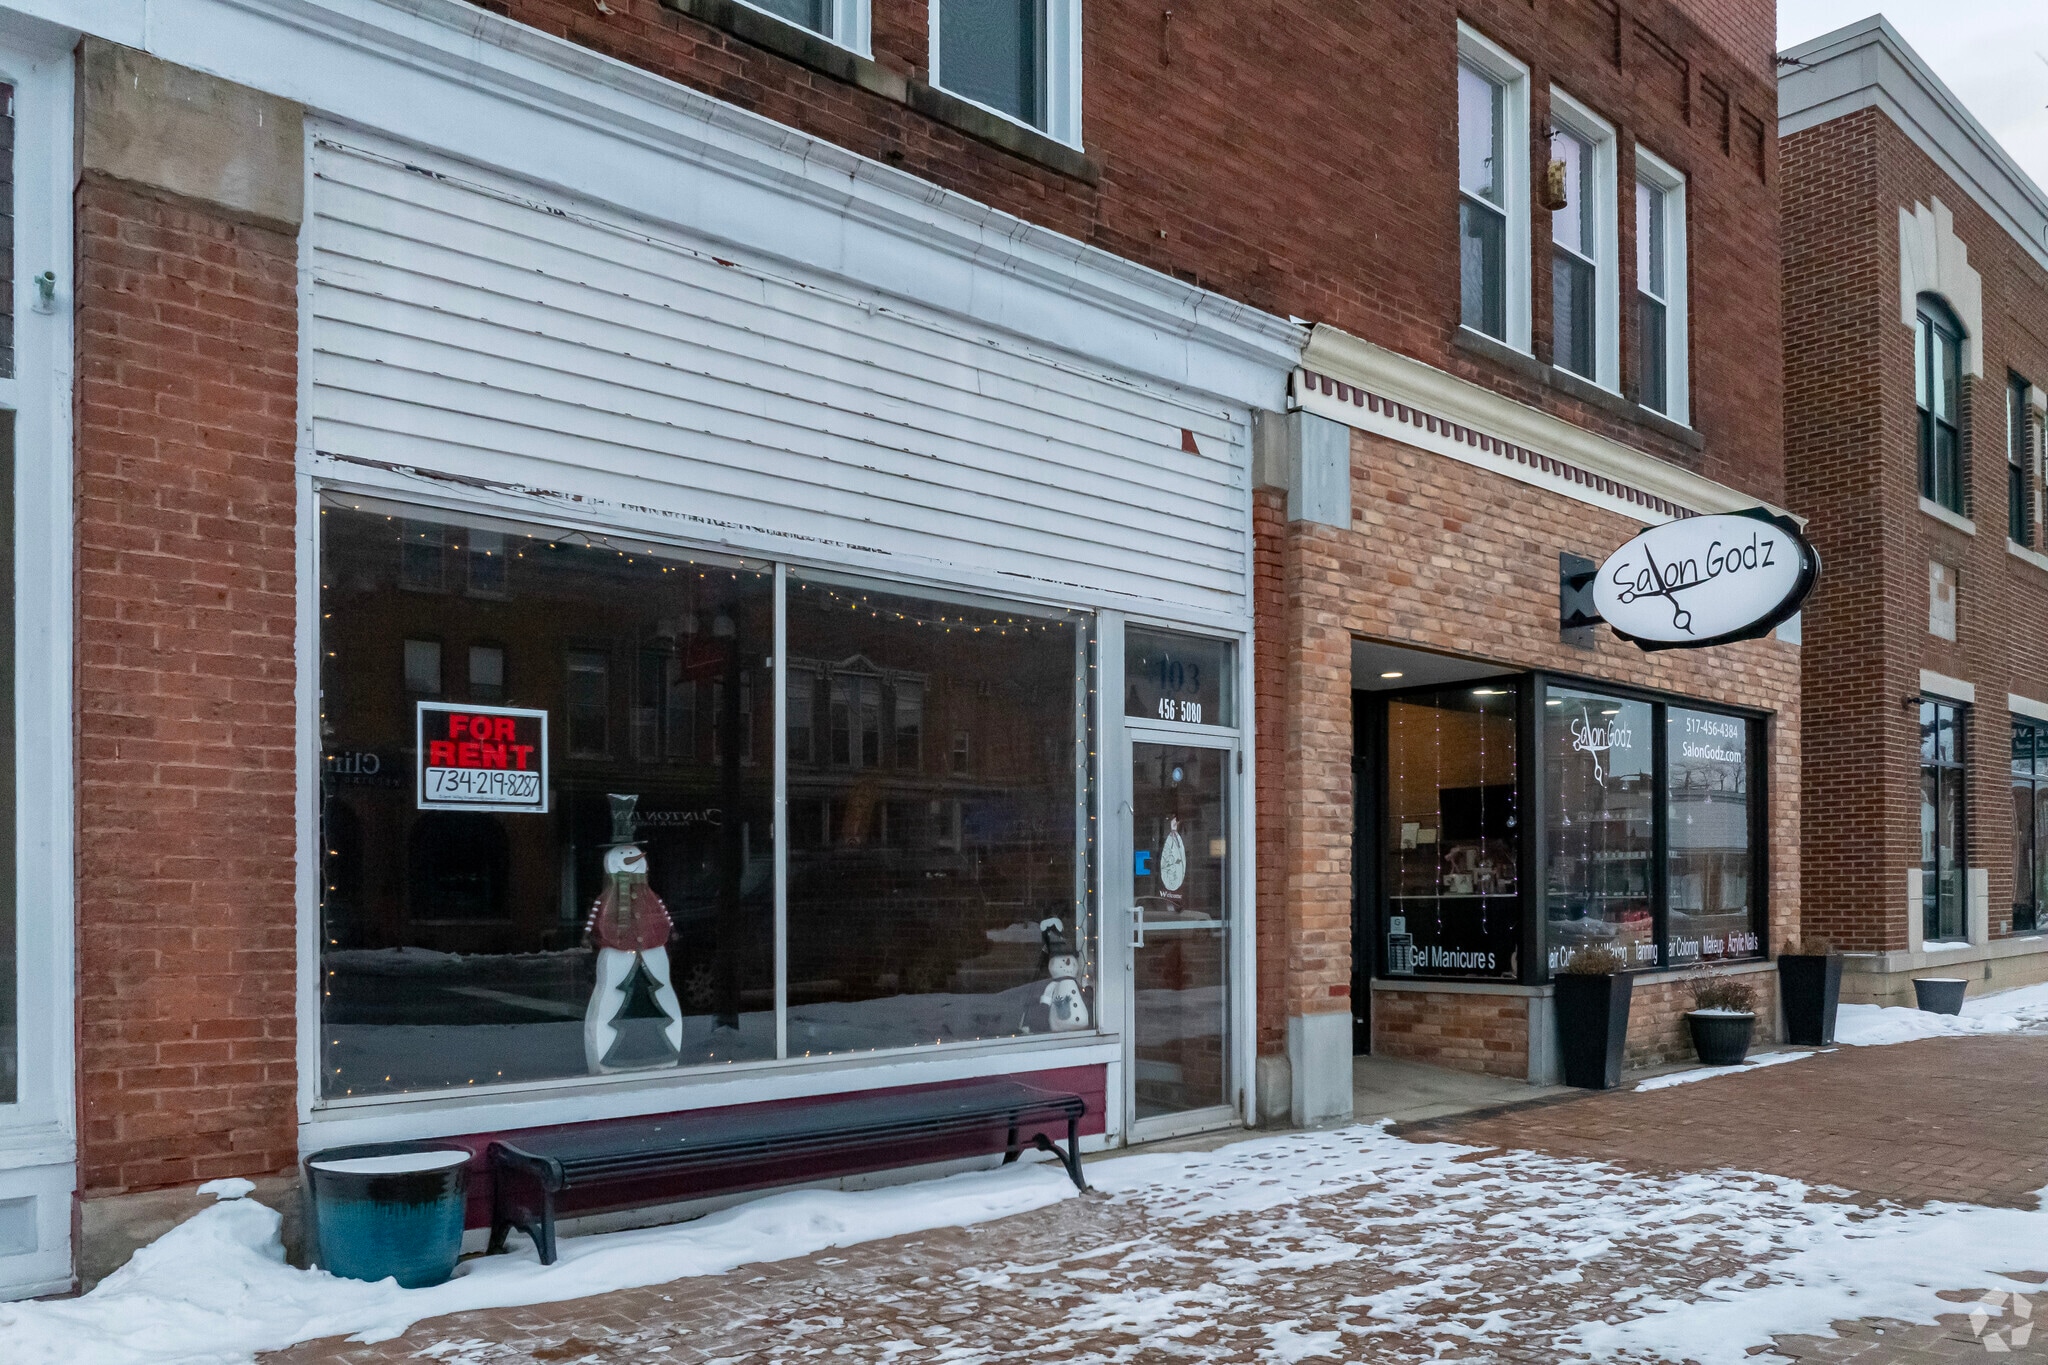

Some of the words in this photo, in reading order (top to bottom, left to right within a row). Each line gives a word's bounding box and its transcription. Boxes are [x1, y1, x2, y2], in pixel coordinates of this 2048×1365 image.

[1613, 542, 1698, 592] Salon
[1706, 531, 1775, 578] Godz
[449, 713, 516, 743] FOR
[1571, 707, 1605, 750] Salon
[1608, 720, 1632, 748] Godz
[1686, 718, 1738, 739] 517-456-4384
[430, 740, 535, 771] RENT
[1683, 741, 1742, 763] SalonGodz.com
[429, 769, 539, 798] 734-219-8287
[1409, 945, 1428, 967] Gel
[1635, 940, 1658, 965] Tanning
[1676, 936, 1699, 960] Coloring
[1703, 935, 1725, 957] Makeup
